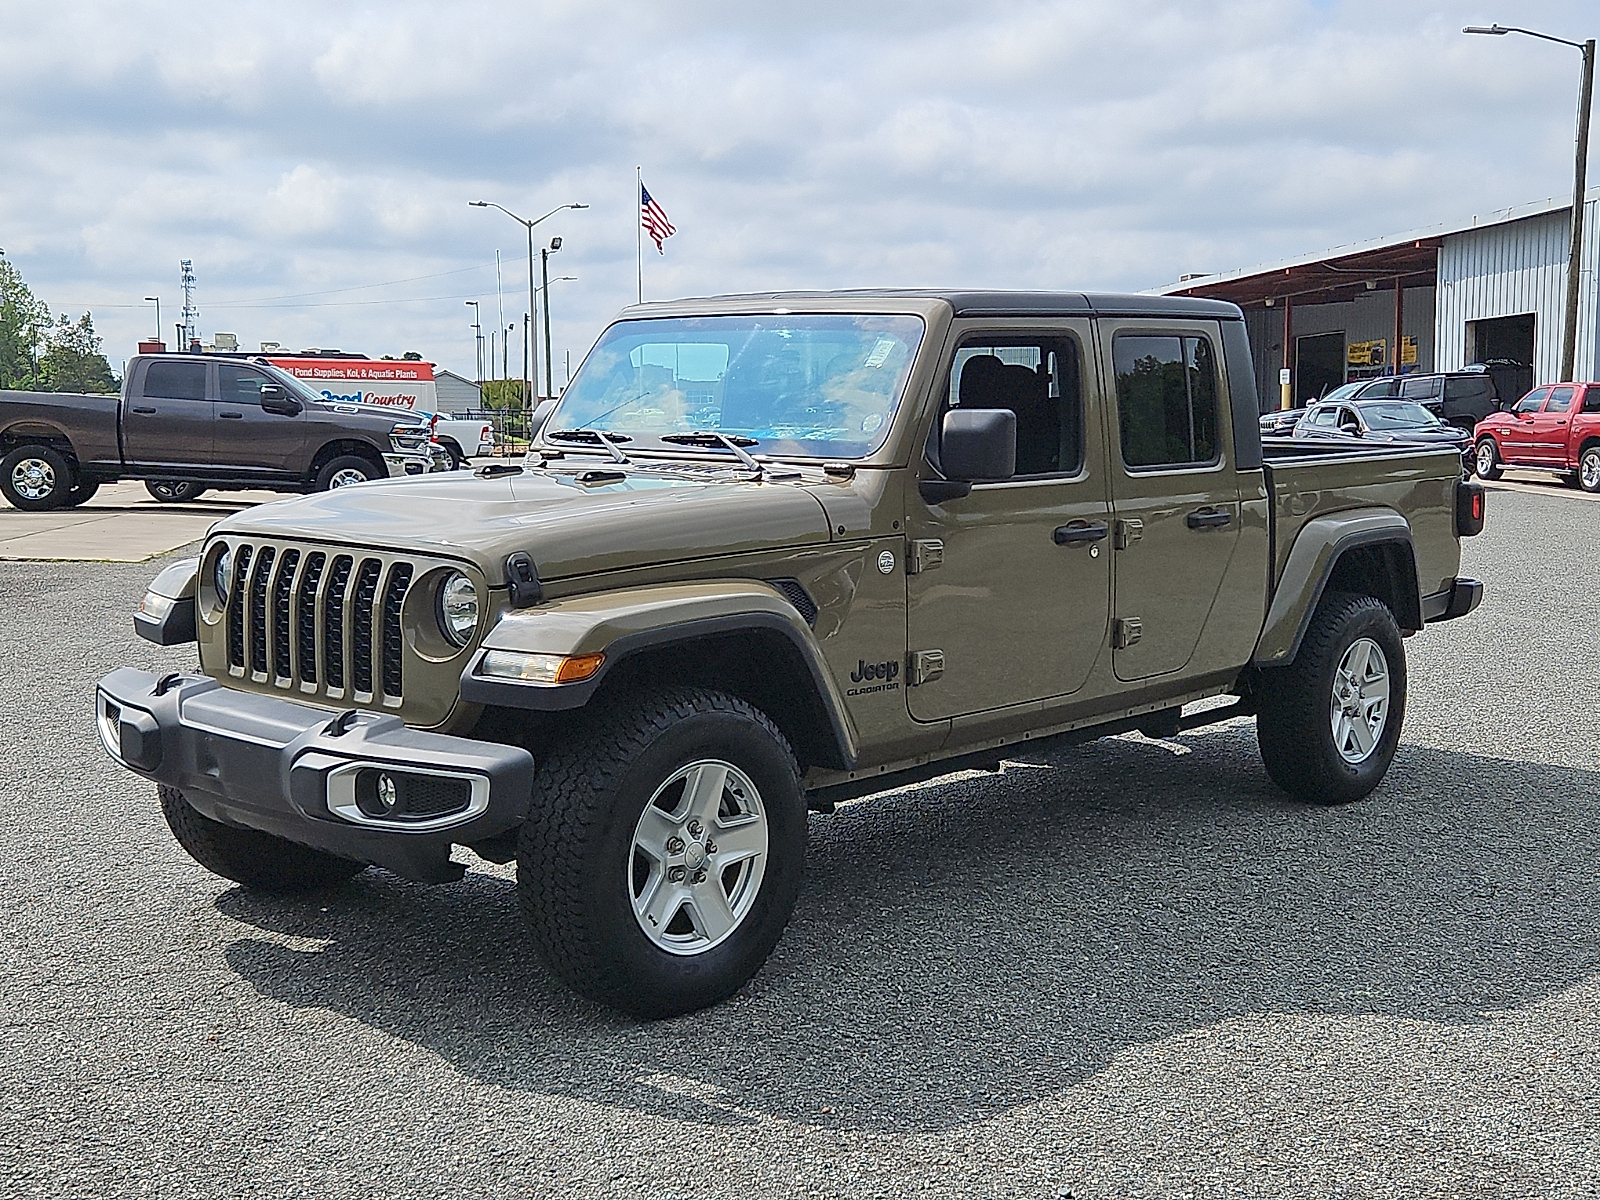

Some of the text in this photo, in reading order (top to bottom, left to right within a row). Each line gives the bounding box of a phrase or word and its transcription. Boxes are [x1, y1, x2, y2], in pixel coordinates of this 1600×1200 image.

[295, 368, 312, 376] Pond
[314, 368, 345, 378] Supplies,
[361, 369, 367, 377] &
[368, 369, 394, 379] Aquatic
[395, 370, 417, 378] Plants
[364, 393, 416, 410] Country
[851, 660, 899, 683] Jeep
[847, 683, 899, 696] GLADIATOR
